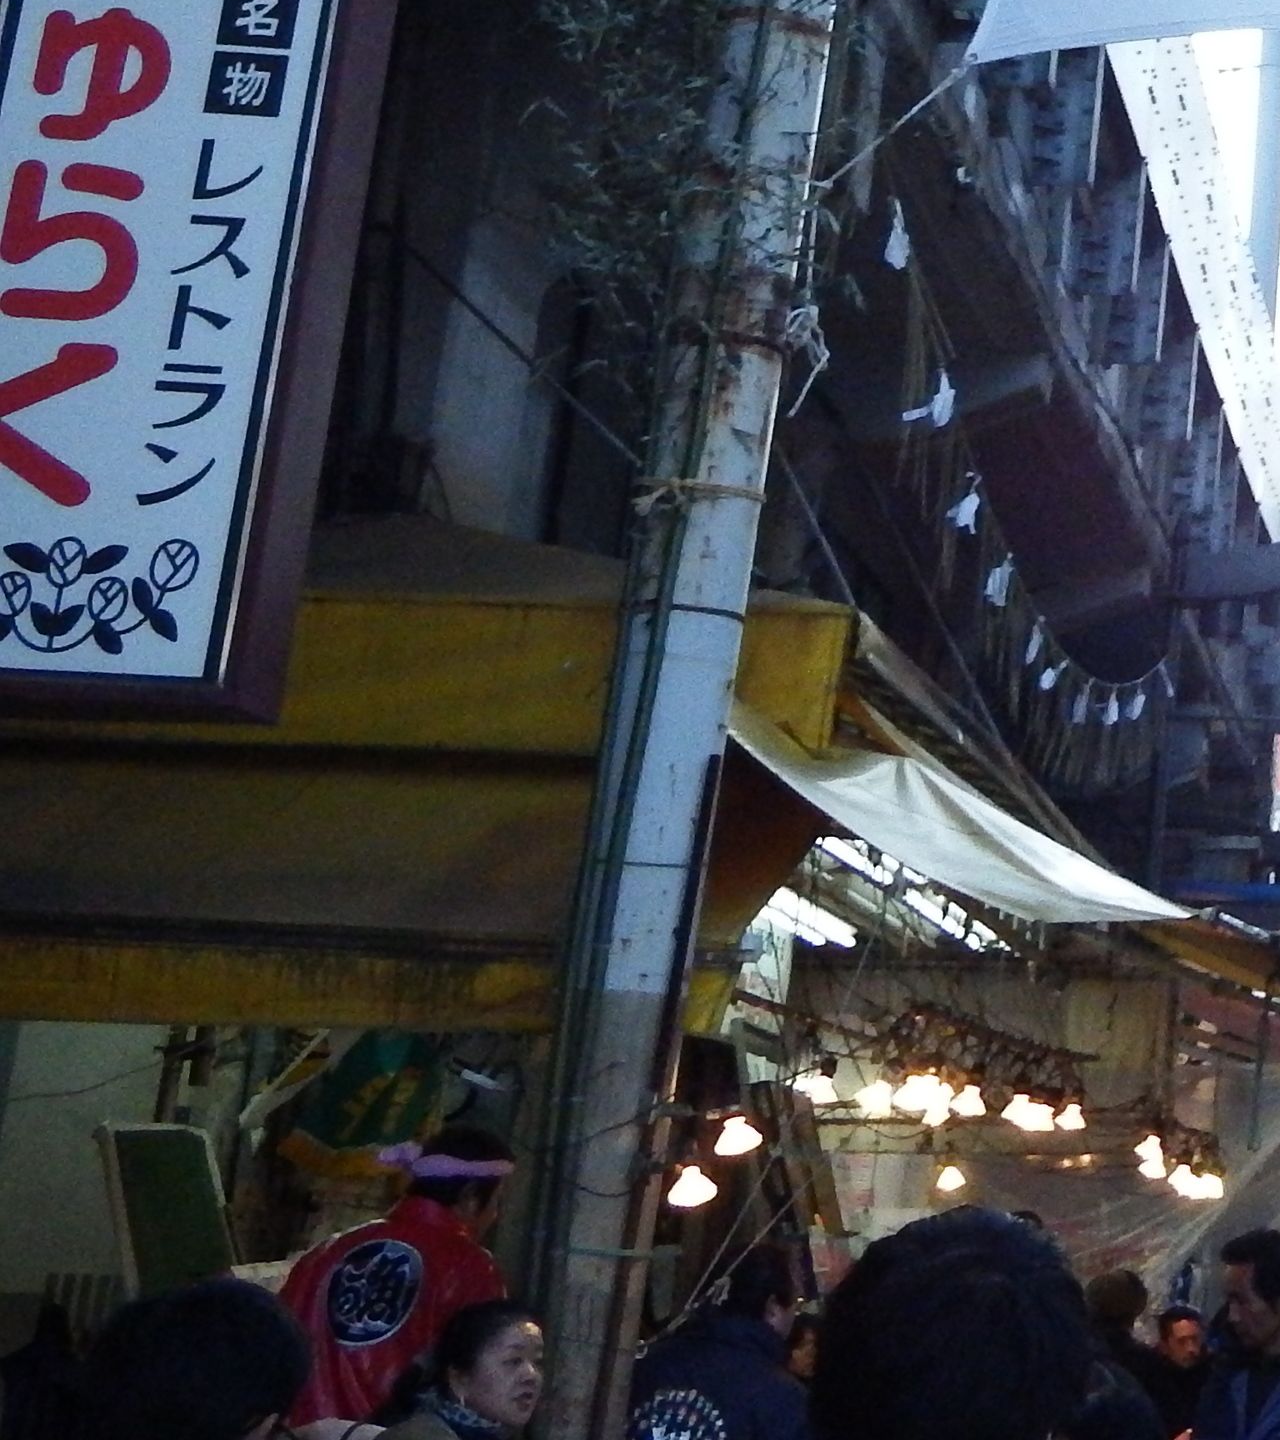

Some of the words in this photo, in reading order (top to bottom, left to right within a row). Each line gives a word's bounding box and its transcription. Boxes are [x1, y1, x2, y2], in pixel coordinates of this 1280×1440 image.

[135, 137, 264, 507] レストラン
